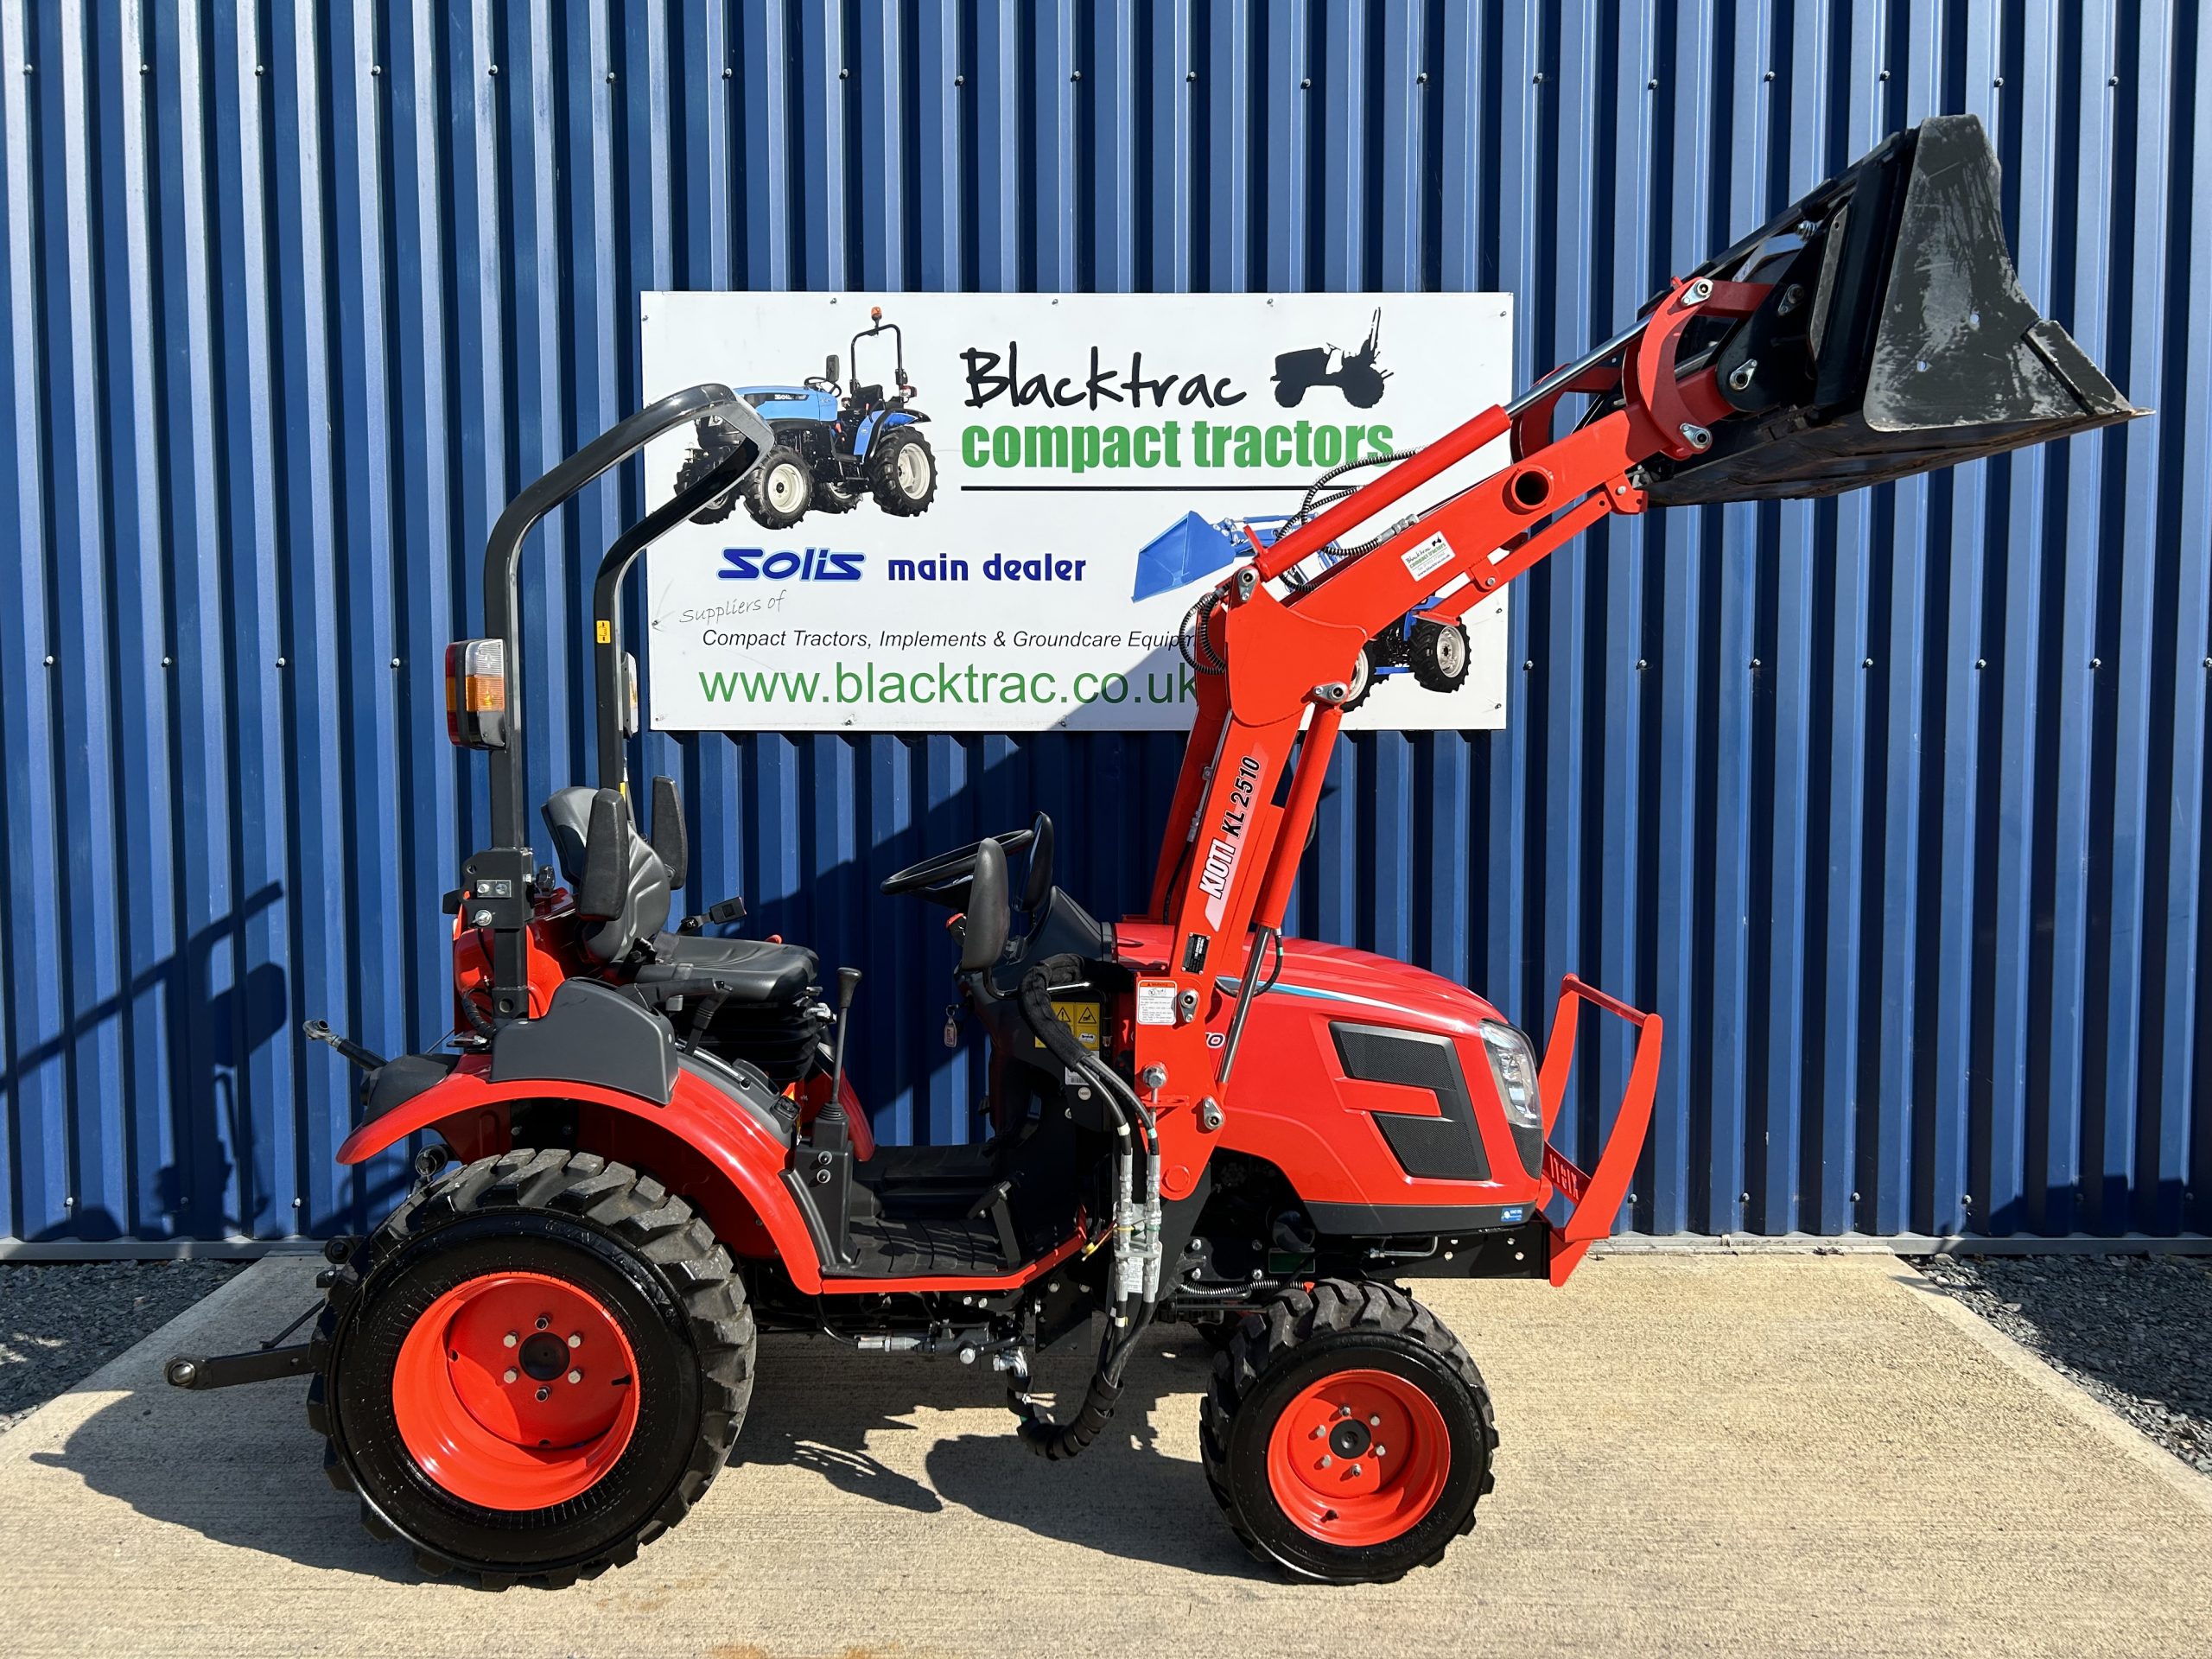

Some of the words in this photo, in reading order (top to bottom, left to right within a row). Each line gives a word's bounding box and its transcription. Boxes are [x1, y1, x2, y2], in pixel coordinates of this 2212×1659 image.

[960, 341, 1247, 411] Blacktrac
[963, 421, 1181, 474] compact
[1192, 421, 1394, 468] tractors
[717, 548, 866, 582] Solis
[888, 553, 969, 582] main
[983, 553, 1086, 582] dealer
[679, 599, 761, 625] Suppliers
[767, 589, 787, 612] of
[702, 630, 786, 650] Compact
[793, 630, 872, 650] Tractors,
[880, 630, 987, 651] Implements
[994, 630, 1007, 647] &
[1013, 630, 1122, 647] Groundcare
[699, 662, 1196, 704] www.blacktrac.co.uk
[1230, 755, 1262, 815] 2510
[1221, 808, 1246, 839] KL
[1198, 836, 1236, 899] KIOTI
